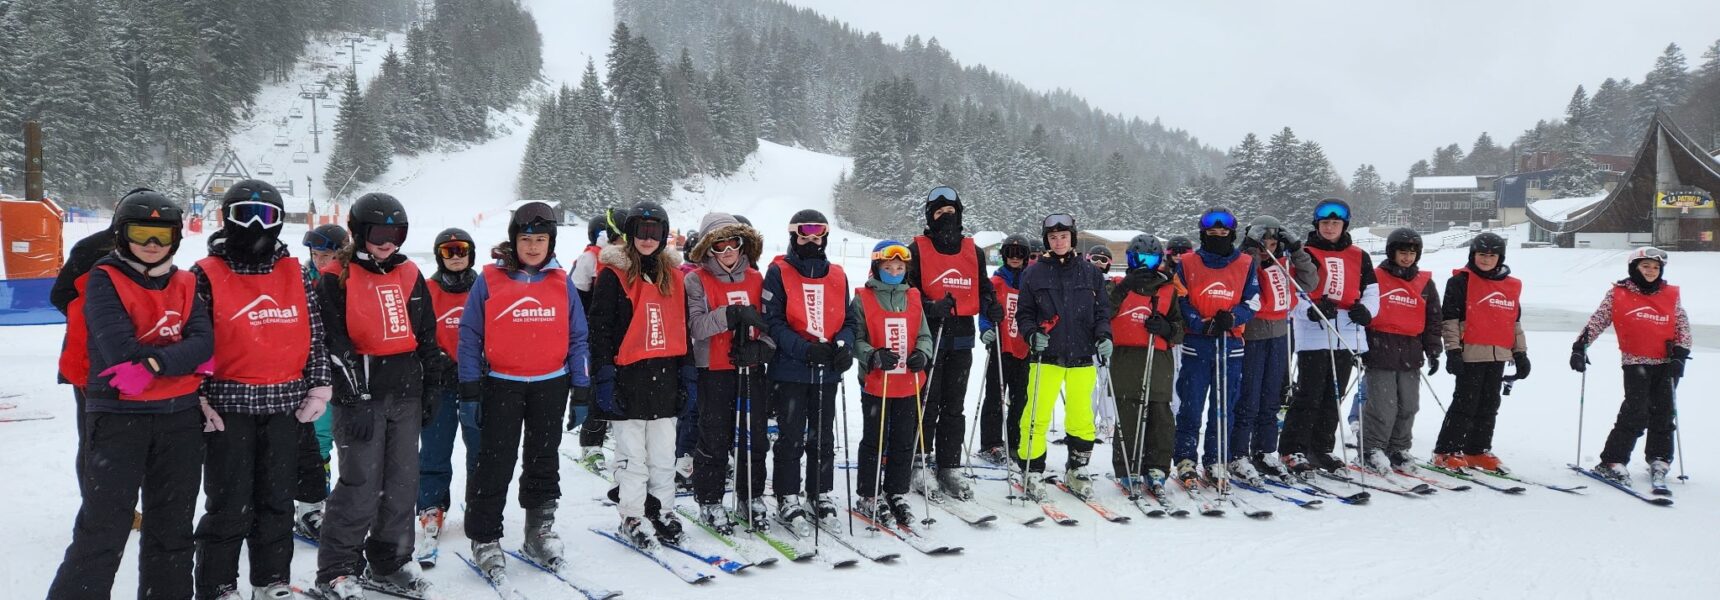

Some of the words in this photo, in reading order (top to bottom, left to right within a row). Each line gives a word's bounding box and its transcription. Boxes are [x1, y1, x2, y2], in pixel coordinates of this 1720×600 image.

[942, 277, 971, 286] cantal
[1328, 261, 1338, 295] cantal
[1208, 289, 1234, 298] cantal
[1269, 269, 1285, 306] cantal
[1389, 294, 1417, 305] cantal
[1489, 298, 1515, 307] cantal
[247, 305, 298, 321] cantal
[380, 289, 400, 333] cantal
[512, 307, 556, 318] cantal
[805, 289, 818, 331] cantal
[1636, 312, 1669, 322] cantal
[649, 307, 659, 346] cantal
